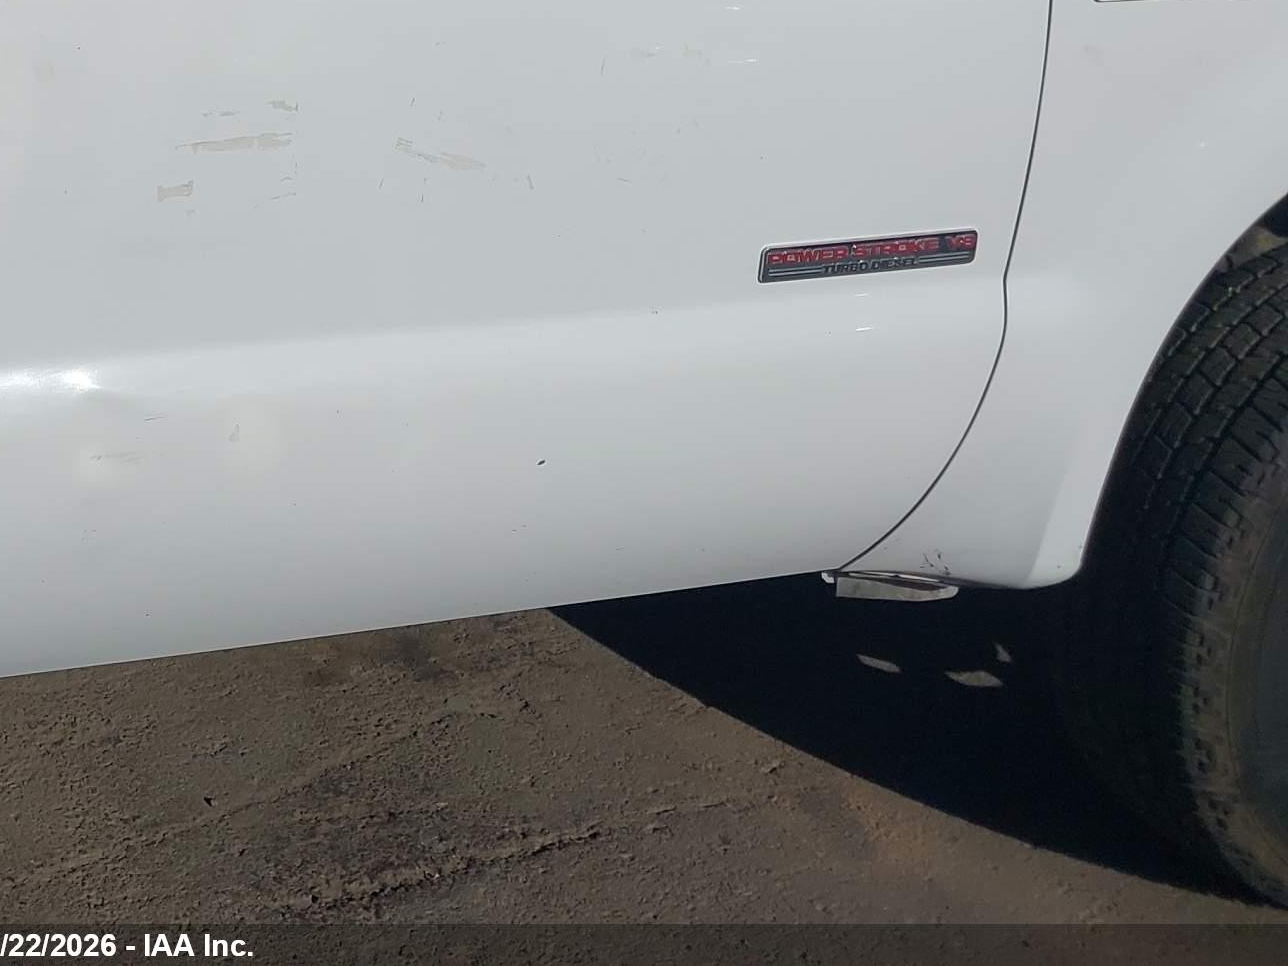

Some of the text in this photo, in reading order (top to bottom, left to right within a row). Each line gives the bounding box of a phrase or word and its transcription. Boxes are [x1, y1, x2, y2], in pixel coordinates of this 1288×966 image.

[767, 233, 976, 265] POWER STROKE V8
[823, 256, 920, 275] TURBO DIESEL
